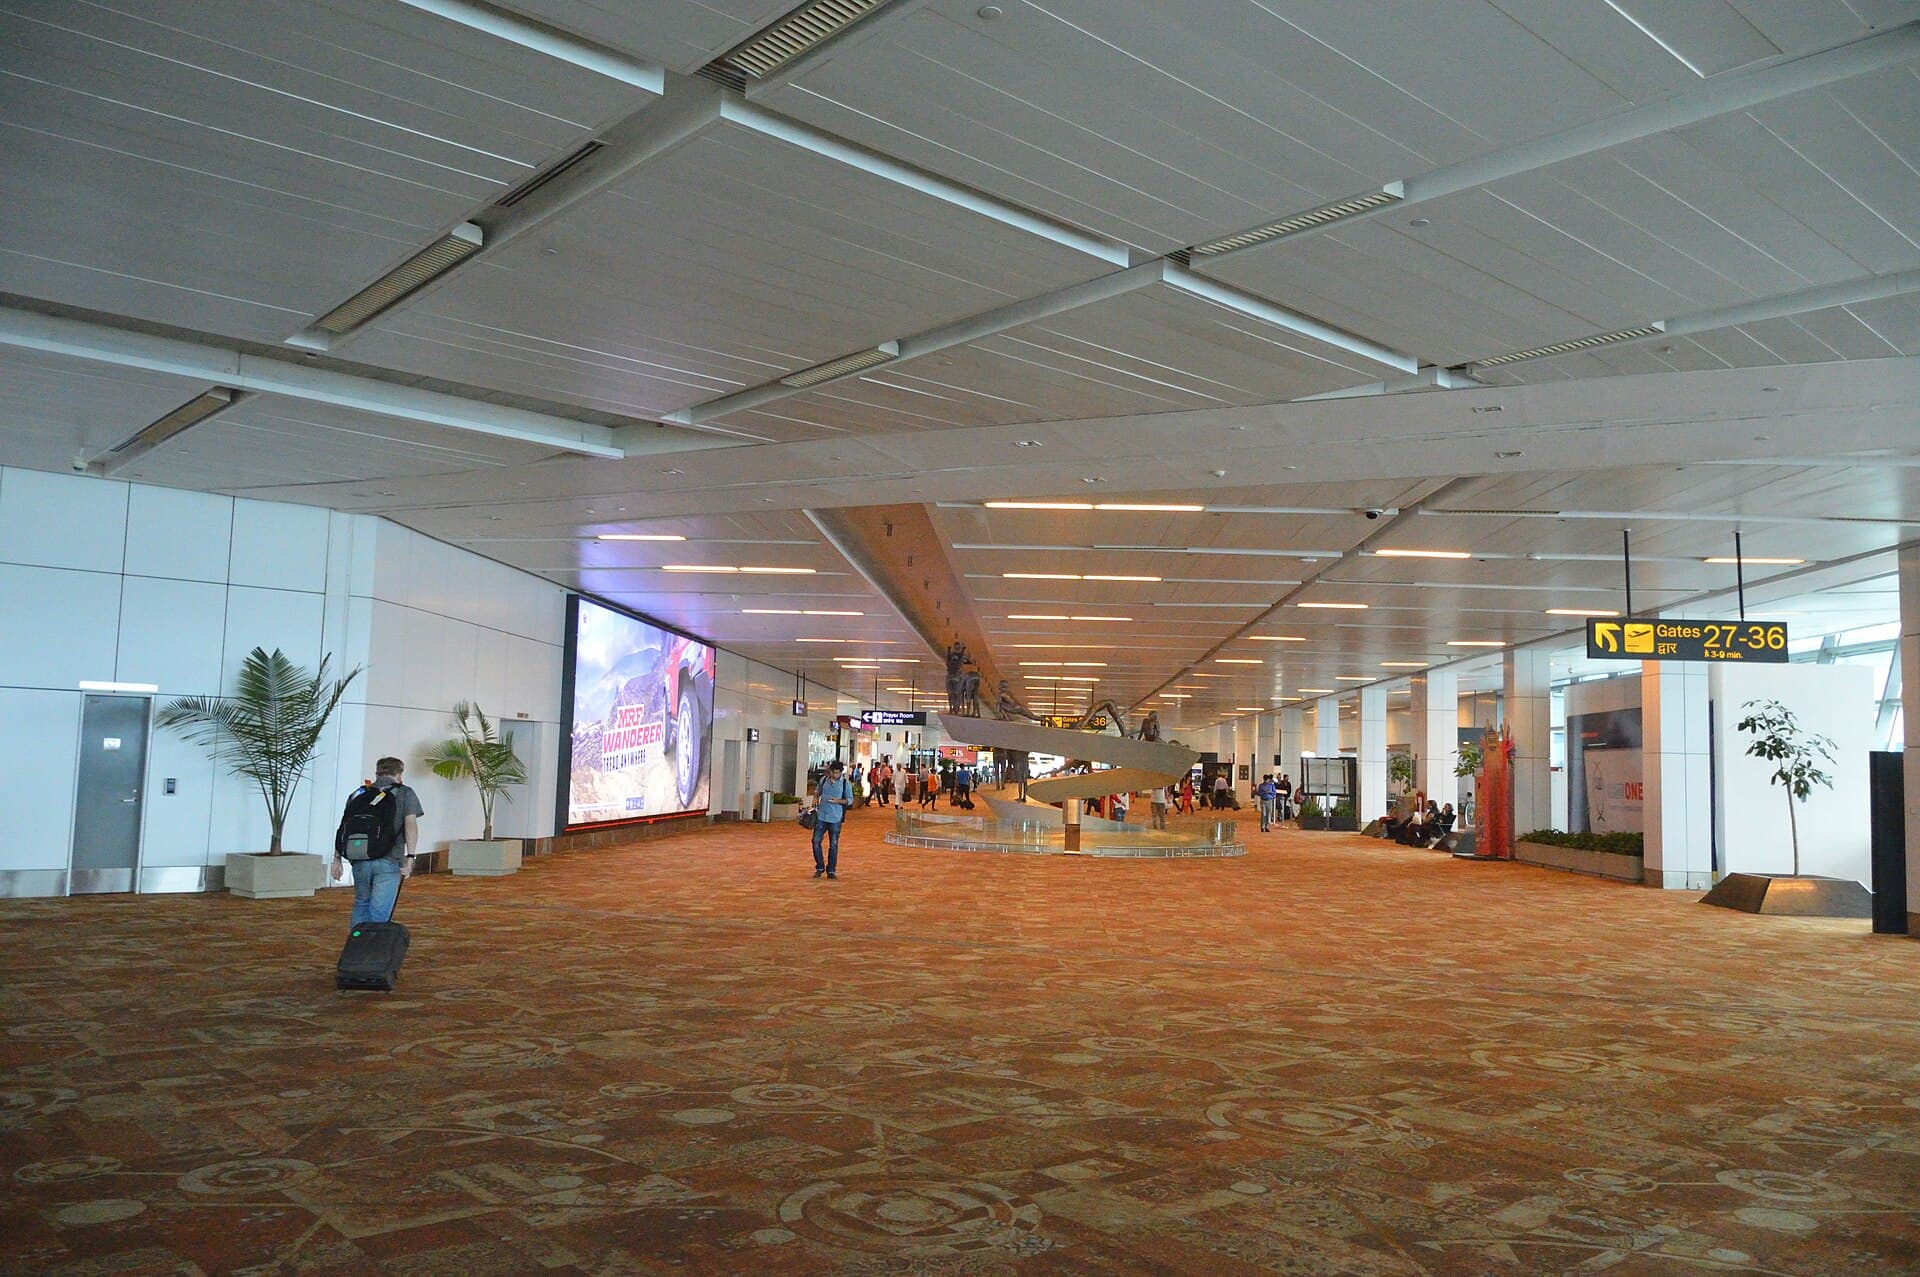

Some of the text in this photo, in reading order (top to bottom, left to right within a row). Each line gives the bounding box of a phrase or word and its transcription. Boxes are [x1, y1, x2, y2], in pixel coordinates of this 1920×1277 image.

[1657, 624, 1785, 650] Gates 27-36
[1657, 643, 1677, 655] द्वार
[1711, 650, 1744, 659] 3-9 min.
[618, 707, 642, 729] MRF
[604, 724, 662, 753] WANDERER
[1625, 782, 1643, 800] ONE
